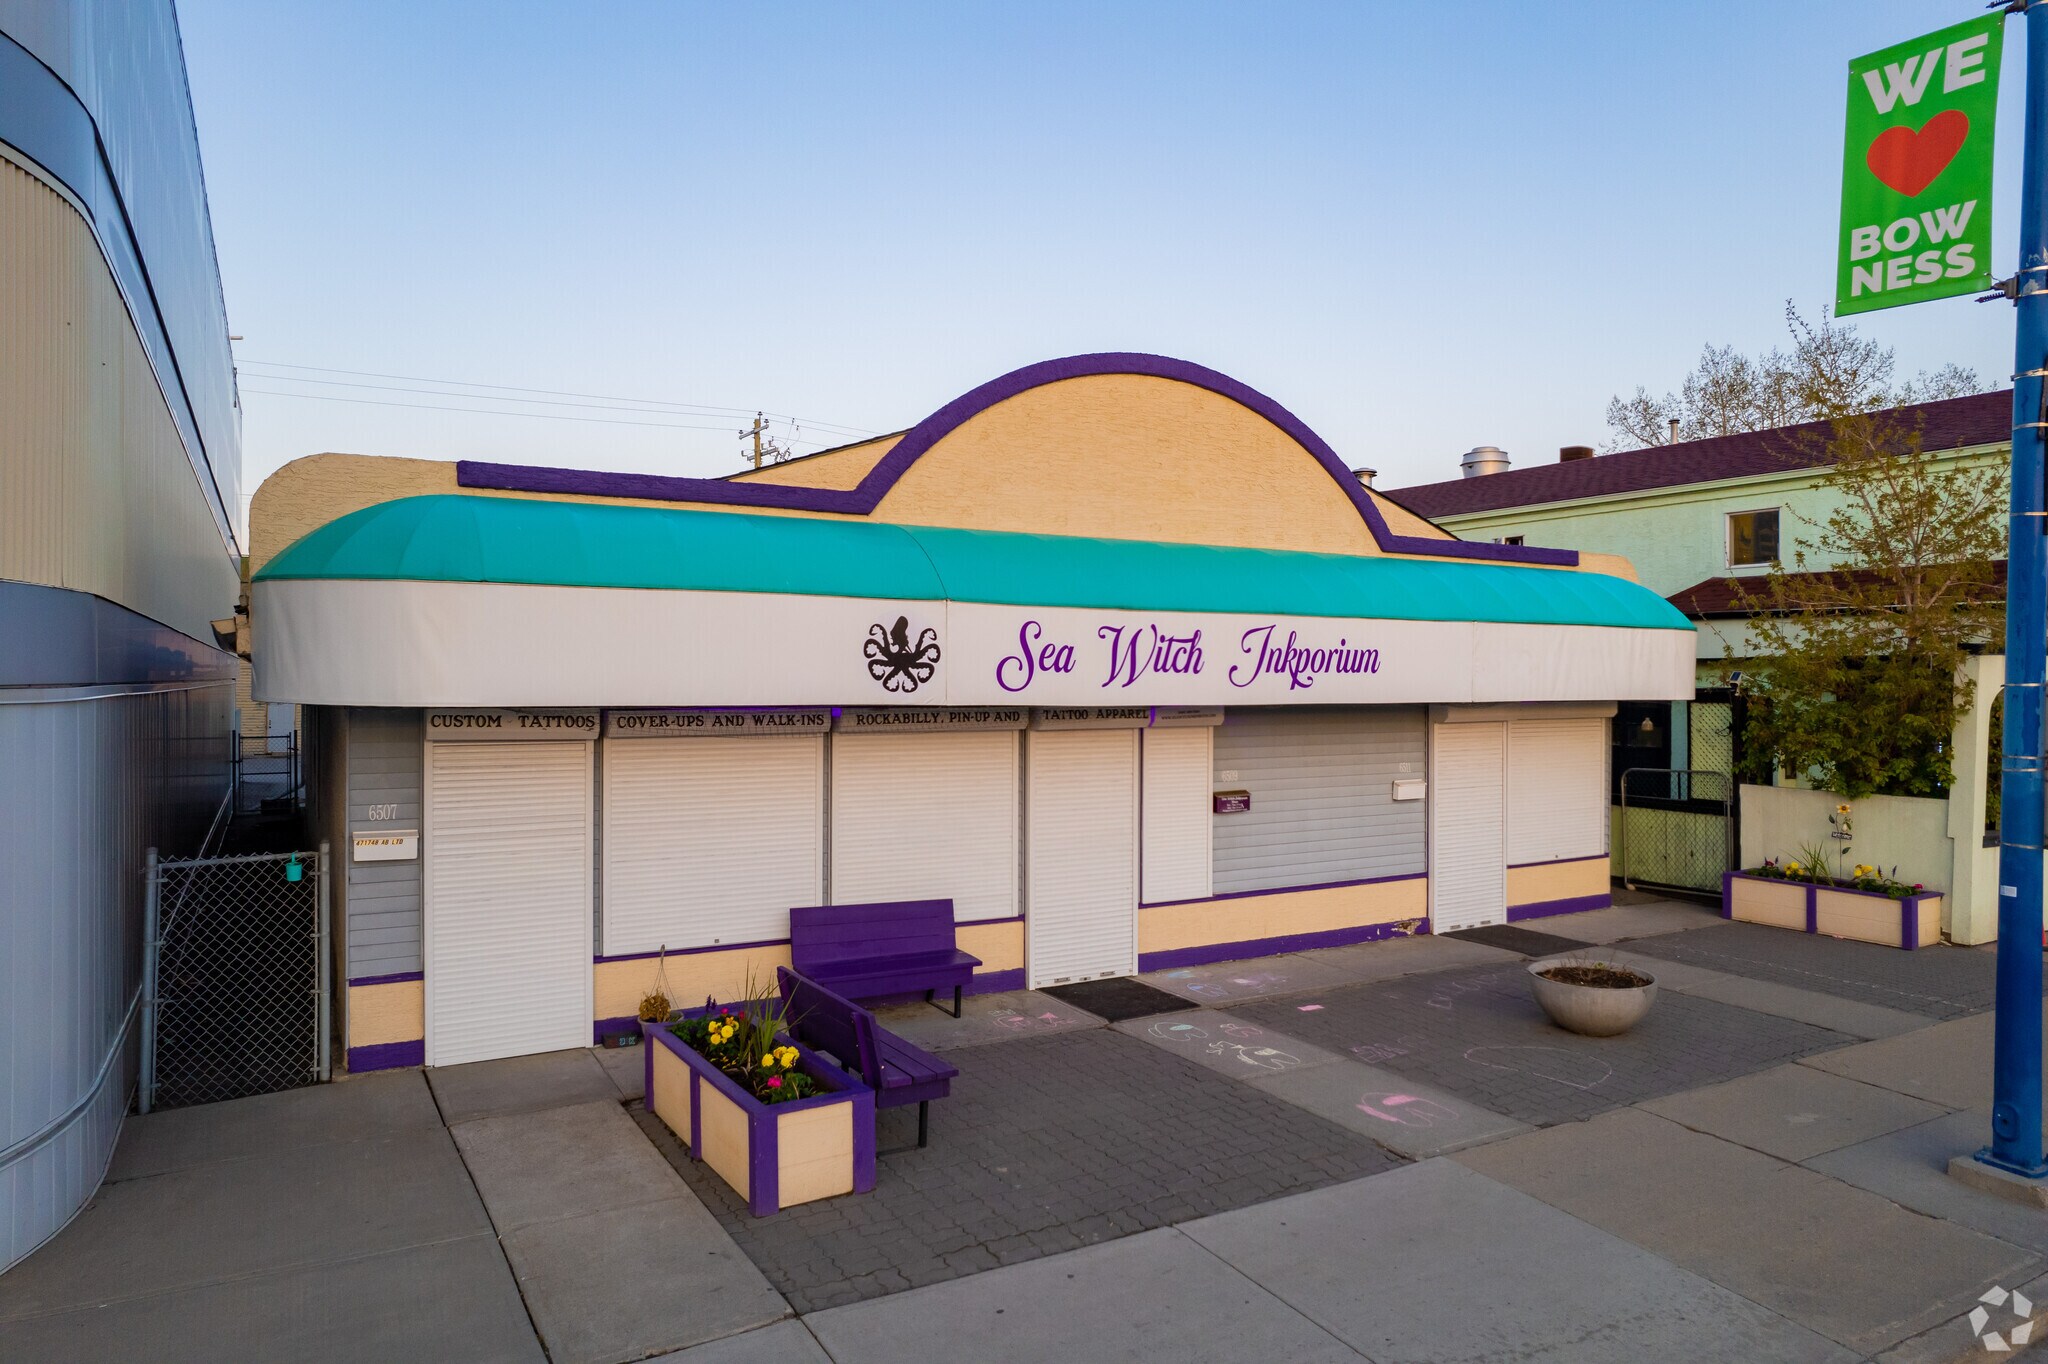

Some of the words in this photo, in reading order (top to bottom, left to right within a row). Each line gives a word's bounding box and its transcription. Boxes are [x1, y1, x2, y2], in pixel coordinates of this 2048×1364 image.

[1862, 32, 1989, 115] WE
[1850, 200, 1977, 262] BOW
[1851, 243, 1976, 297] NESS
[996, 620, 1076, 692] Sea
[1097, 623, 1205, 688] Witch
[1228, 623, 1381, 690] Inkporium
[430, 714, 502, 728] CUSTOM
[518, 715, 595, 728] TATTOOS
[616, 715, 705, 729] COVER-UPS
[712, 715, 745, 727] AND
[752, 714, 825, 726] WALK-INS
[949, 712, 990, 723] PIN-UP
[993, 711, 1021, 722] AND
[1042, 709, 1089, 720] TATTOO
[1096, 708, 1149, 719] APPAREL
[368, 803, 398, 820] 6507
